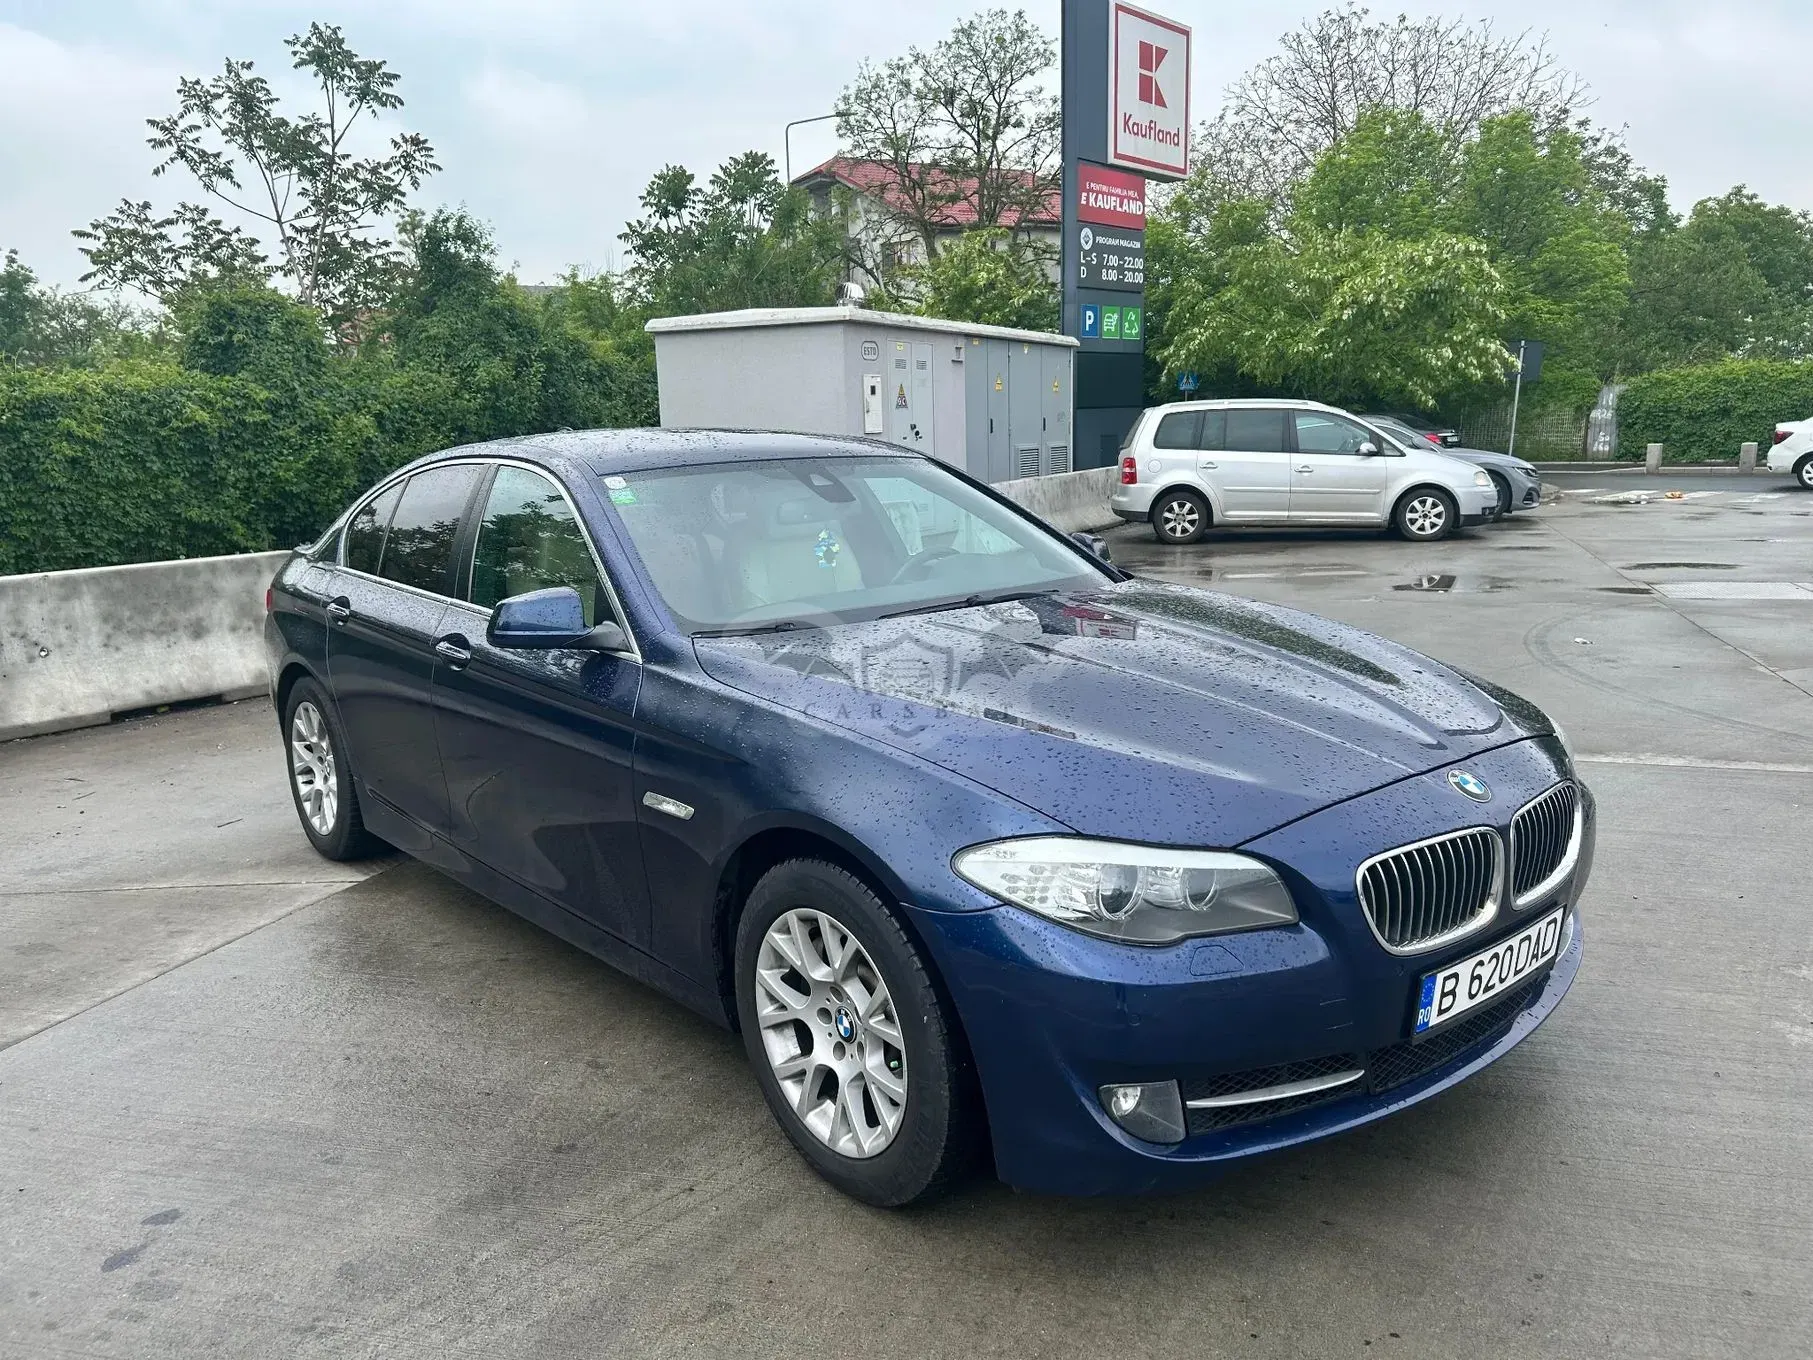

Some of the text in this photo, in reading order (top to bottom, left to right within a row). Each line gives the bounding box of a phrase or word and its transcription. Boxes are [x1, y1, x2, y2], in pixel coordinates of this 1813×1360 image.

[1123, 112, 1180, 147] Kaufland
[1090, 182, 1109, 193] PENTRU
[1081, 192, 1144, 215] E KAUFLAND
[1095, 236, 1141, 249] PROGRAM MAGAZIN
[1080, 266, 1087, 278] D
[1085, 310, 1095, 331] P
[1436, 971, 1460, 1018] B
[1417, 1006, 1431, 1026] RO
